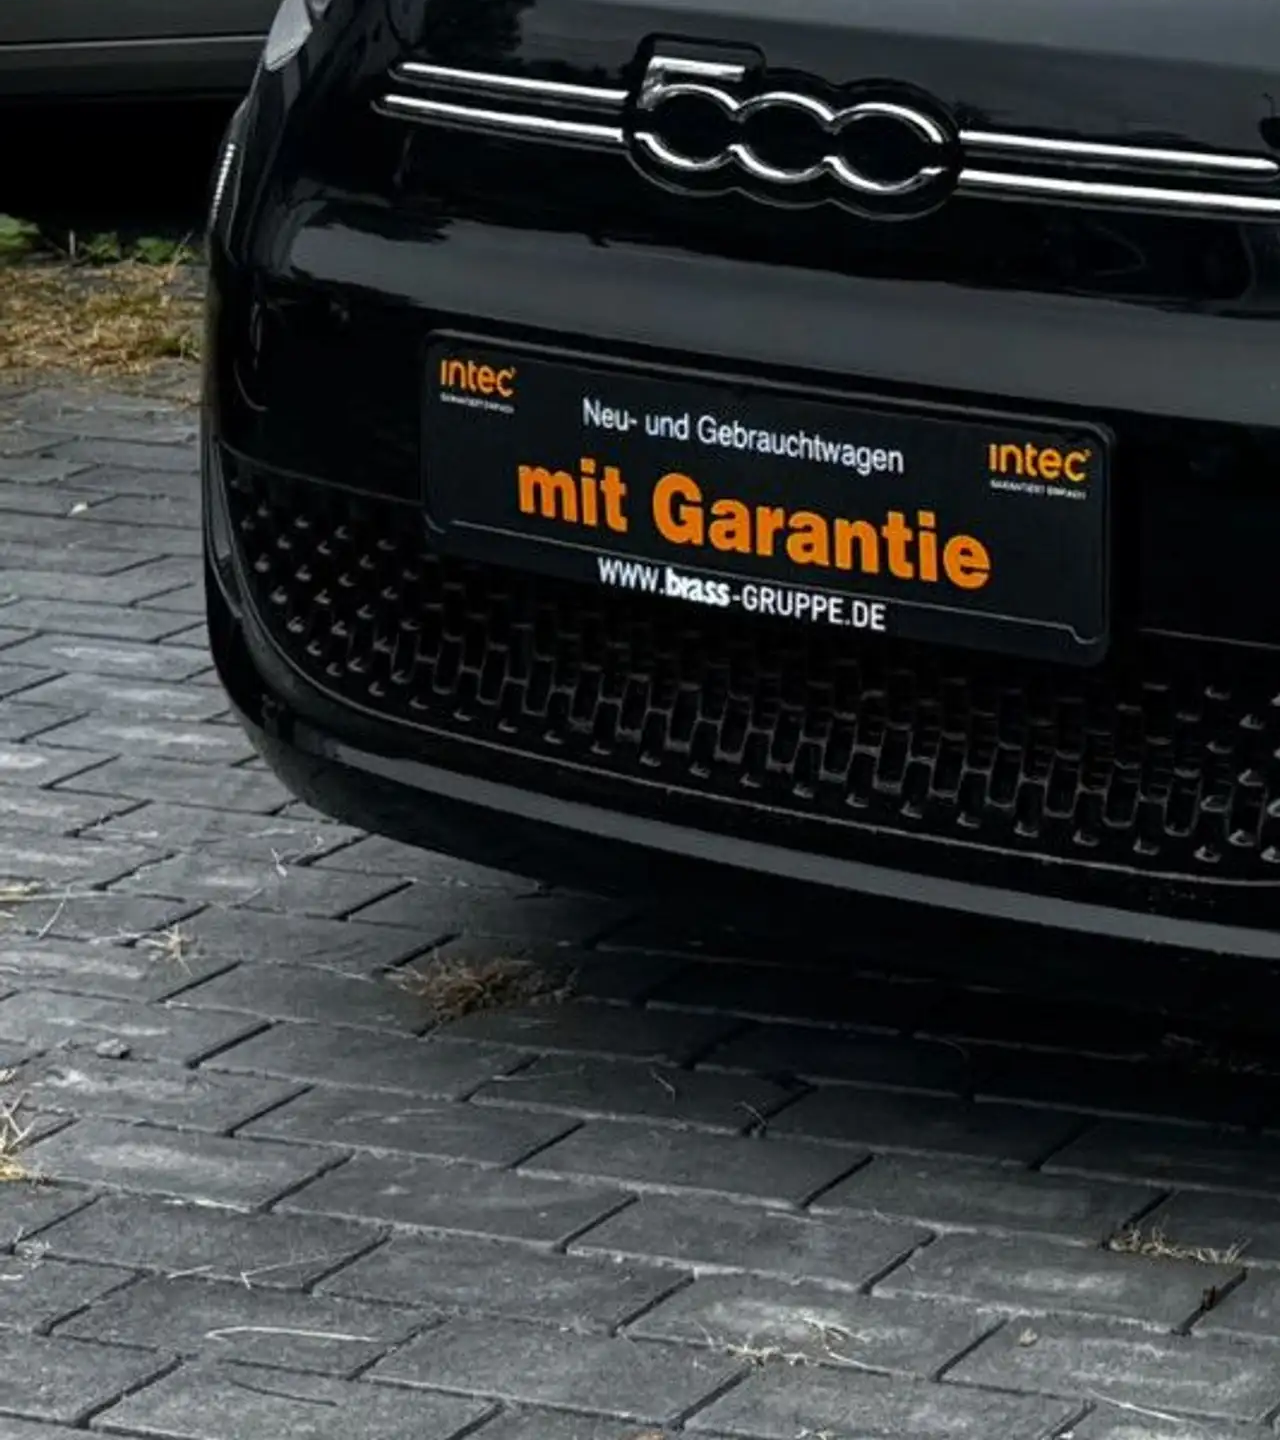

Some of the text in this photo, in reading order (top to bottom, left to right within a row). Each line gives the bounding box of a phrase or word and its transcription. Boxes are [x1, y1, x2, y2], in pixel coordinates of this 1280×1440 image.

[636, 55, 948, 195] 500
[441, 358, 516, 398] intec
[583, 396, 904, 475] Neu- und Gebrauchtwagen
[989, 442, 1092, 482] intec
[518, 458, 991, 590] mit Garantie
